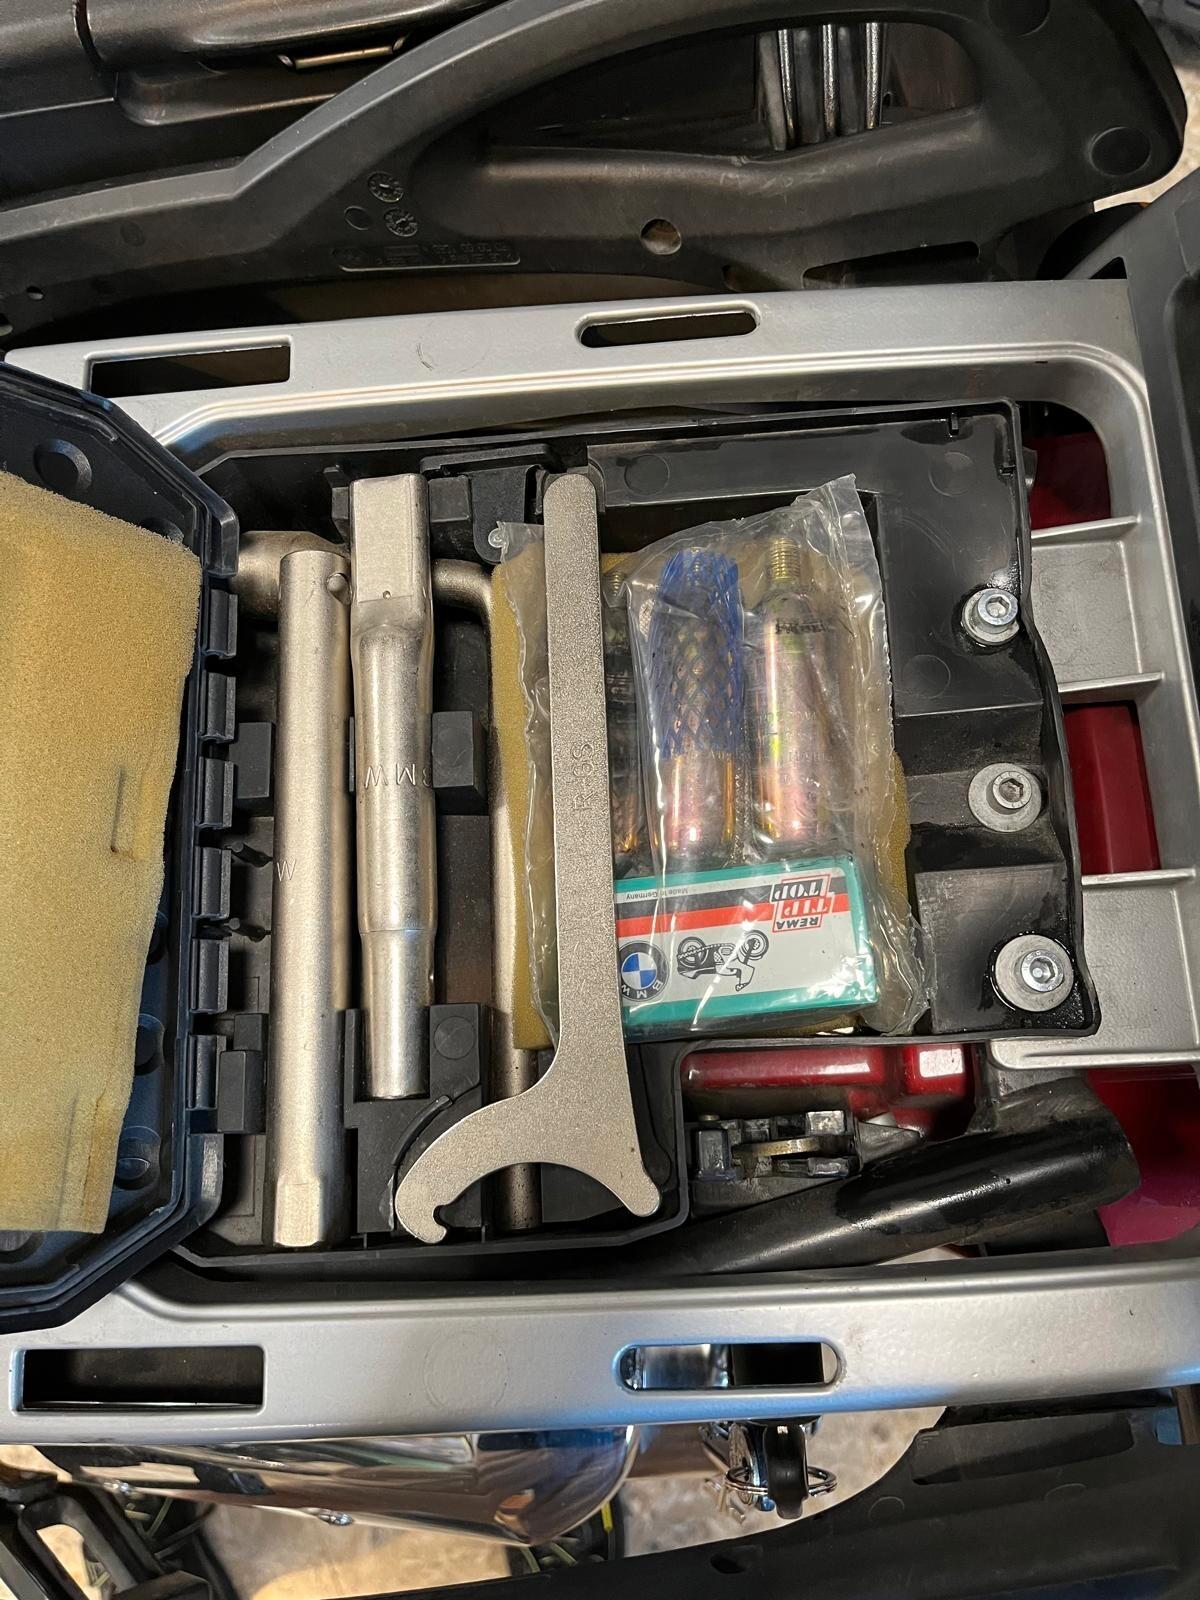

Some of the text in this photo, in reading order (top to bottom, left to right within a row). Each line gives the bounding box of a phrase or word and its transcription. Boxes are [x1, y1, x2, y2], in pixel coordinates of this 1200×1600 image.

[626, 890, 659, 900] Germany
[668, 887, 689, 896] Made
[773, 881, 820, 900] TOP
[783, 898, 830, 917] TIP
[776, 916, 819, 930] REMA
[620, 979, 664, 999] BMW
